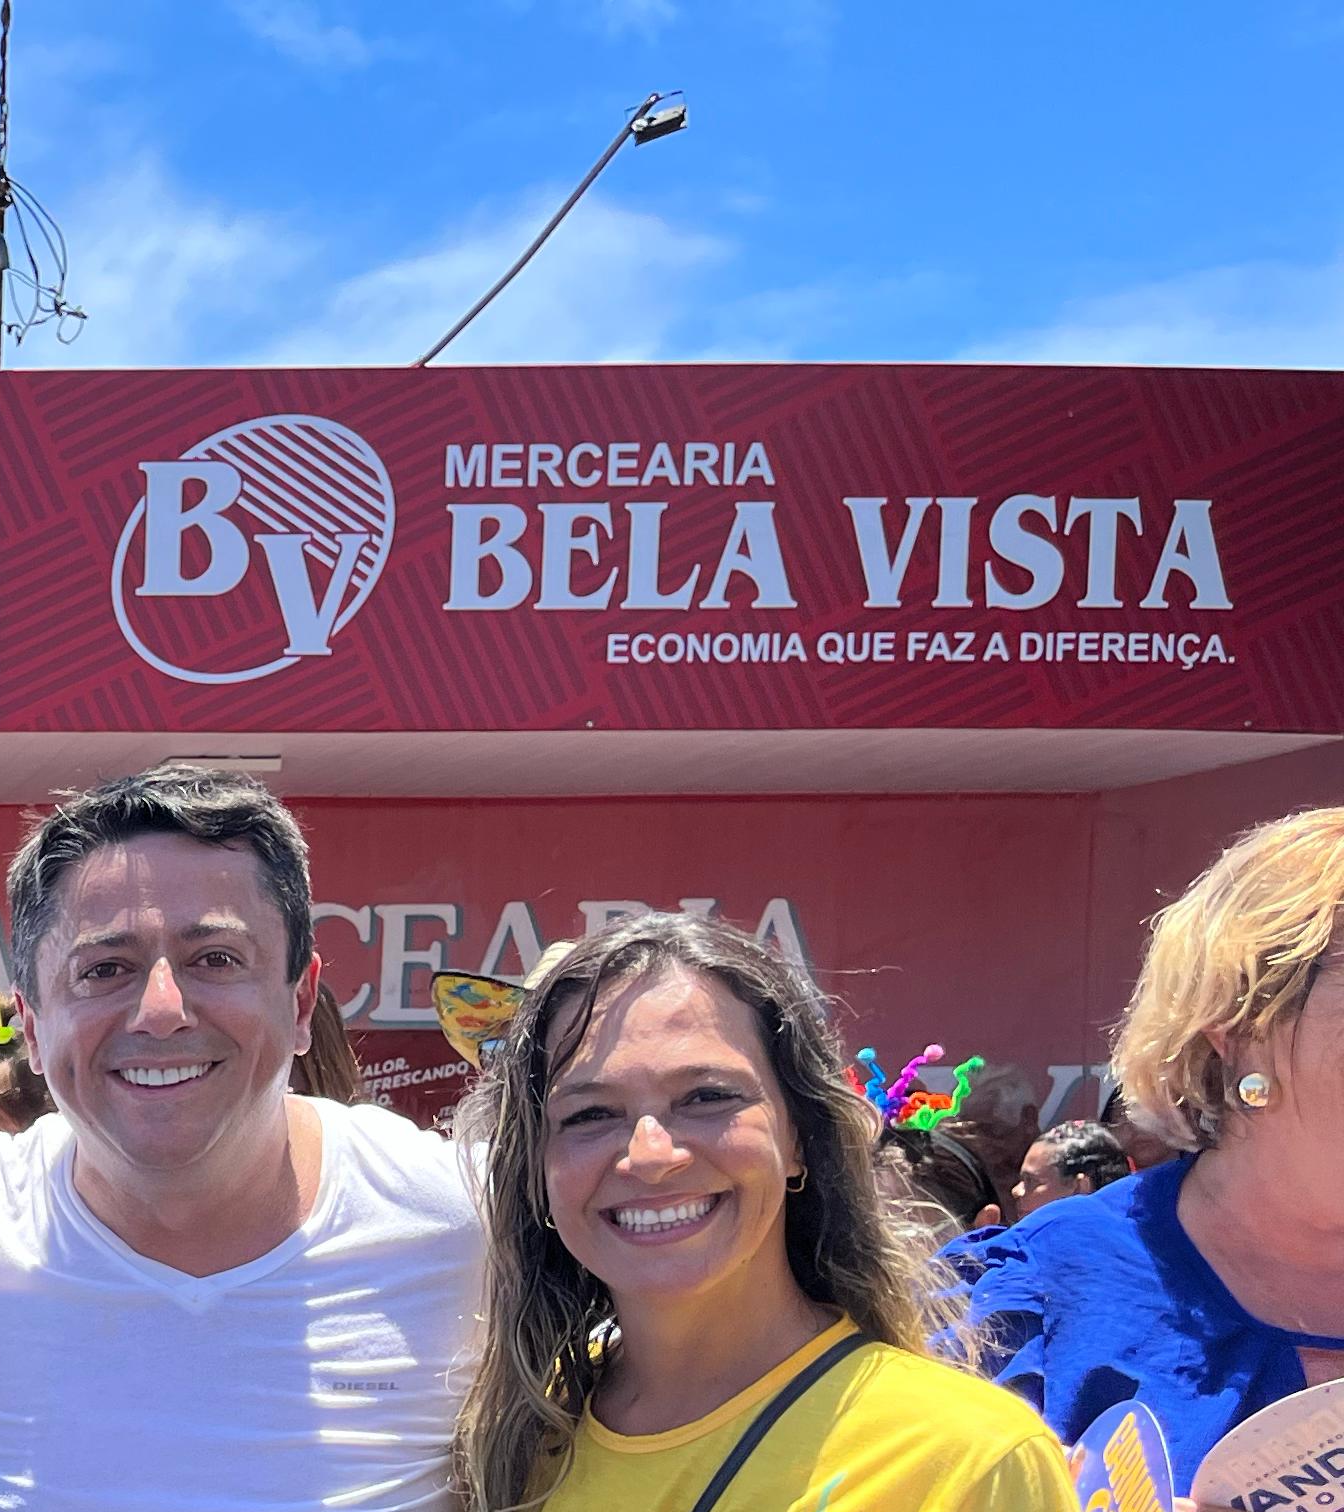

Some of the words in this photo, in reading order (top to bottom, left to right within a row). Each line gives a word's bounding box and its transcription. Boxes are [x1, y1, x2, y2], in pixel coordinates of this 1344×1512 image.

[444, 441, 775, 488] MERCEARIA
[442, 501, 798, 611] BELA
[842, 494, 1234, 611] VISTA
[606, 632, 808, 665] ECONOMIA
[816, 632, 896, 665] QUE
[906, 631, 976, 664] FAZ
[982, 632, 1011, 663] A
[1018, 632, 1238, 669] DIFERENÇA.
[361, 1057, 410, 1077] ALOR.
[362, 1061, 469, 1094] EFRESCANDO
[332, 1381, 400, 1391] DIESEL
